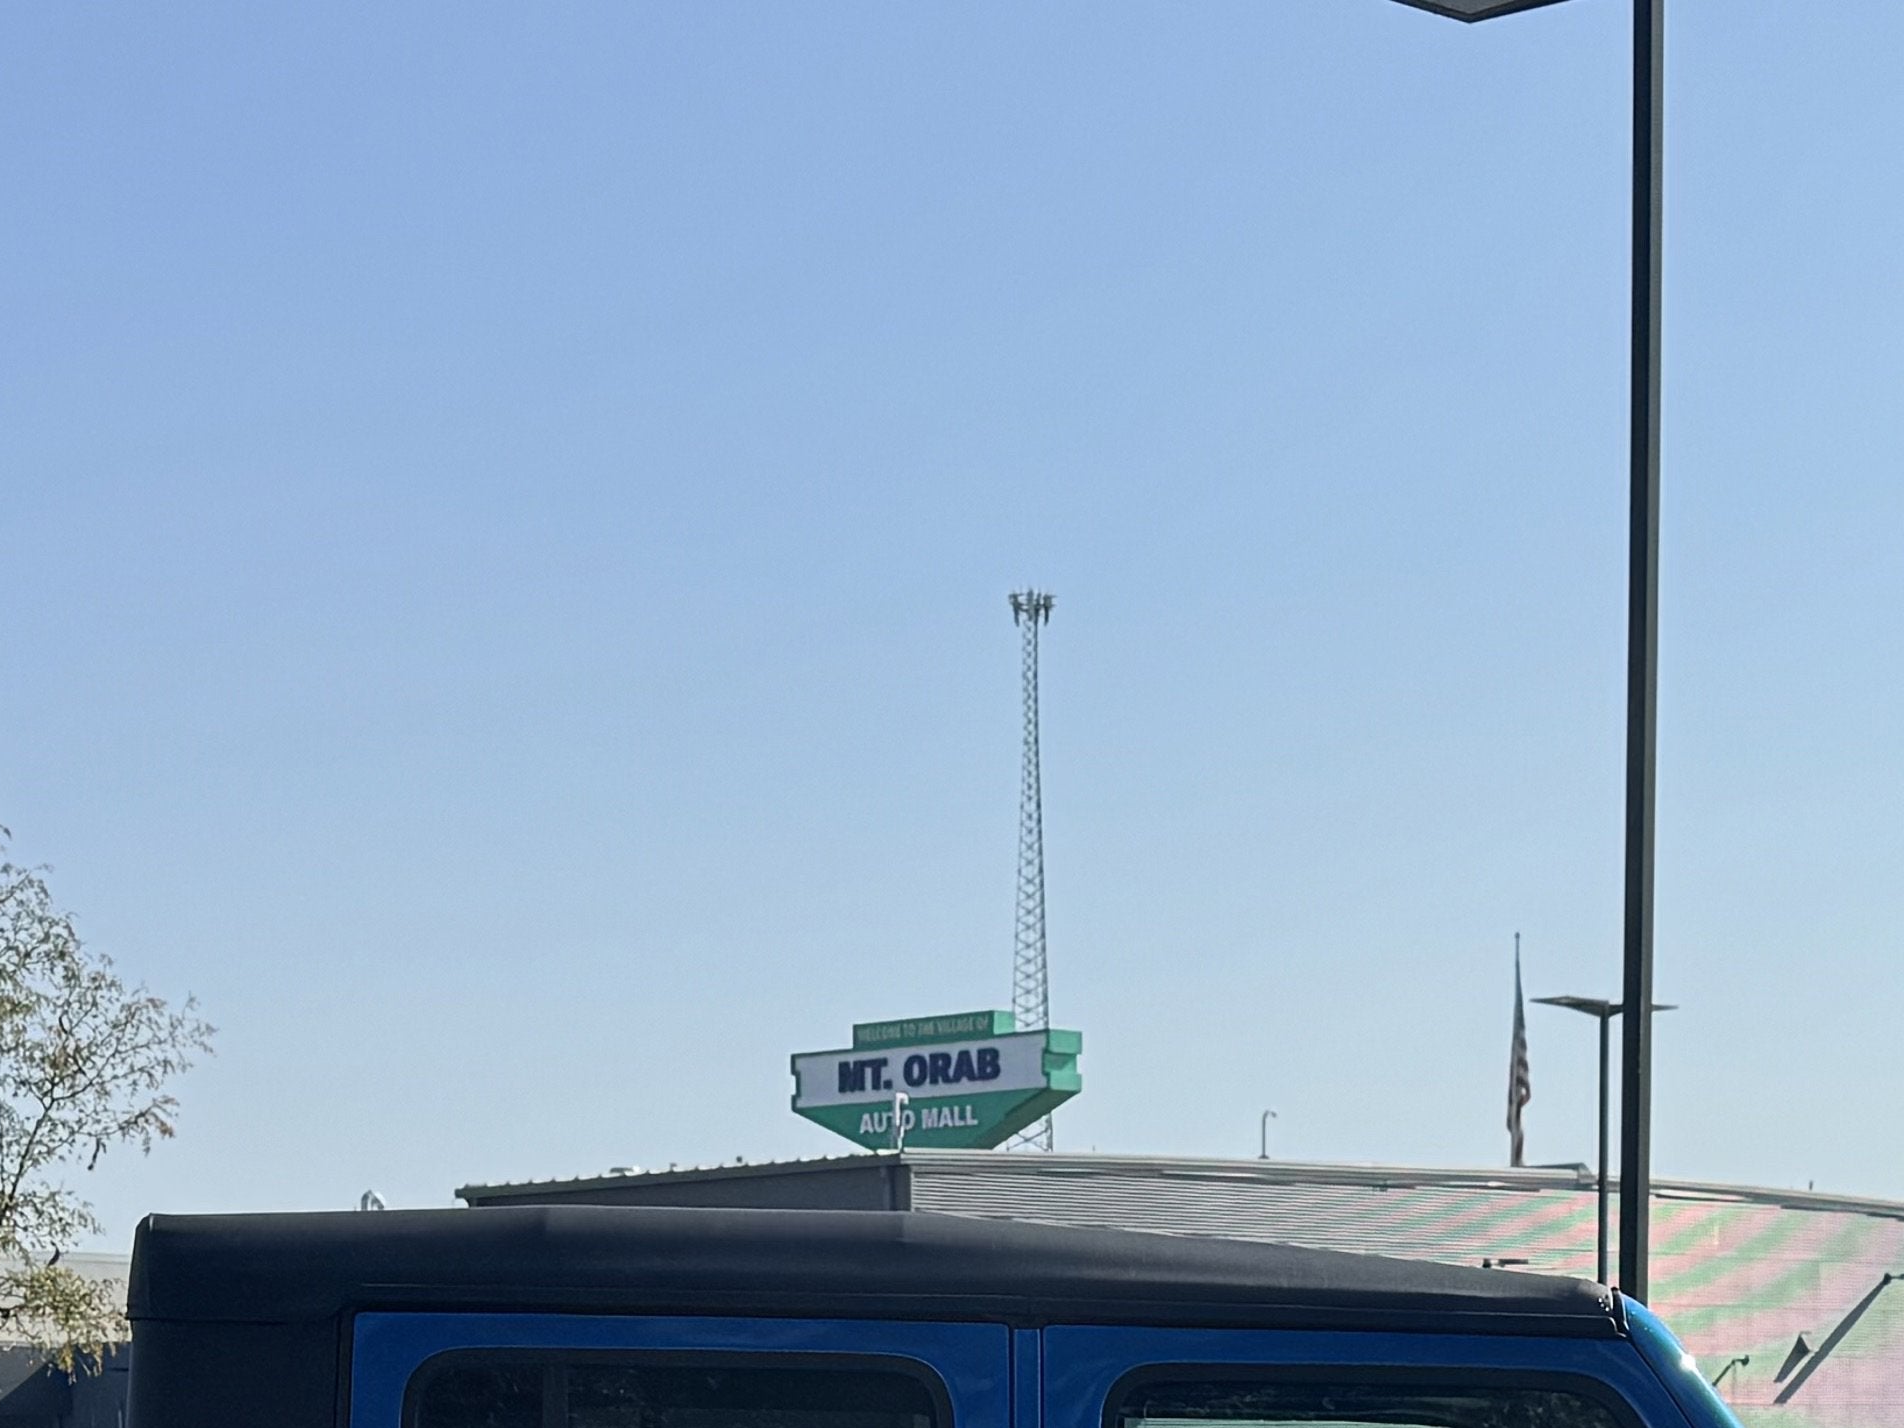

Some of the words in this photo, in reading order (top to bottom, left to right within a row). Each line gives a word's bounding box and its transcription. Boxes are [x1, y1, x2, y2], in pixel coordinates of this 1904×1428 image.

[838, 1057, 893, 1093] MT.
[903, 1047, 1001, 1088] ORAB
[921, 1105, 979, 1130] MALL
